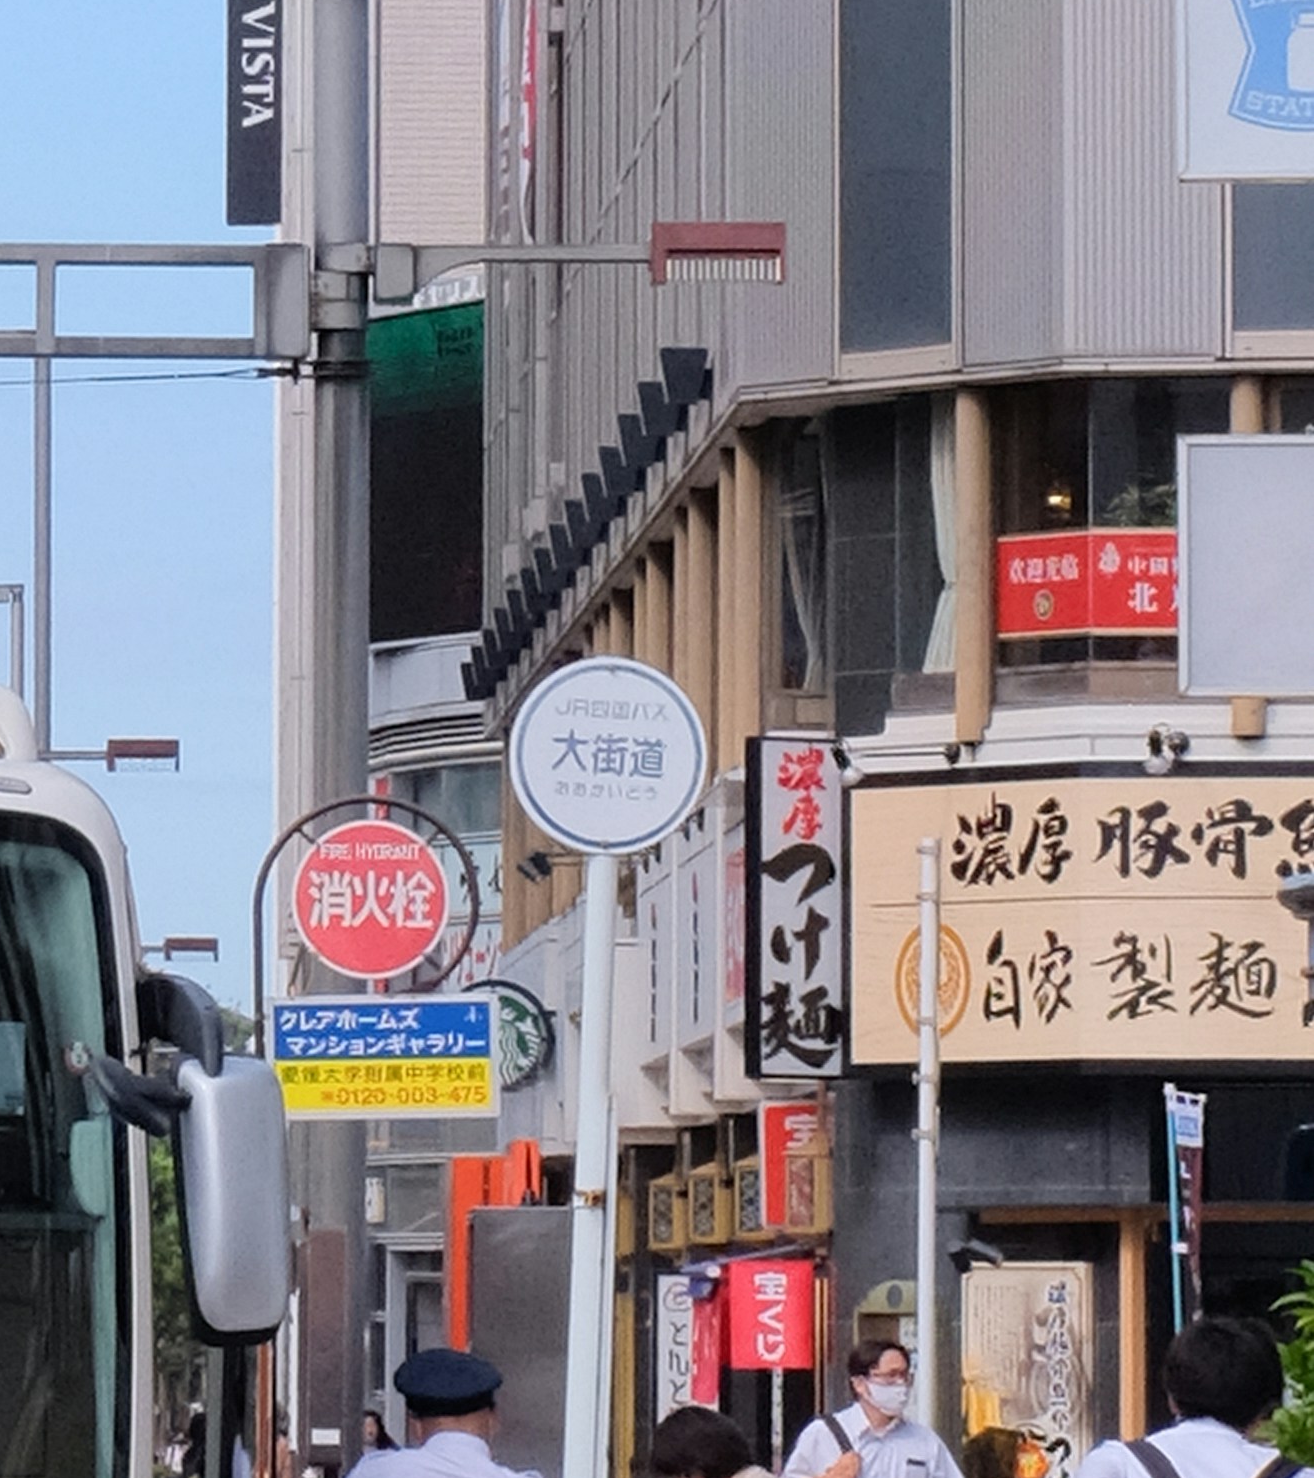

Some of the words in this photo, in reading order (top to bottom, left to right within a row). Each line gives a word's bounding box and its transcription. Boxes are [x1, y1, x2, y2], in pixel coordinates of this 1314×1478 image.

[241, 0, 277, 127] VISTA
[555, 698, 671, 722] JR四国バス
[551, 728, 669, 779] 大街道
[319, 843, 352, 860] FIRE
[355, 844, 421, 860] HYDRANT
[307, 869, 436, 929] 消火栓
[280, 1007, 420, 1031] クレアホームズ
[284, 1034, 487, 1056] マンションギャラリー
[753, 1271, 789, 1363] 宝くじ
